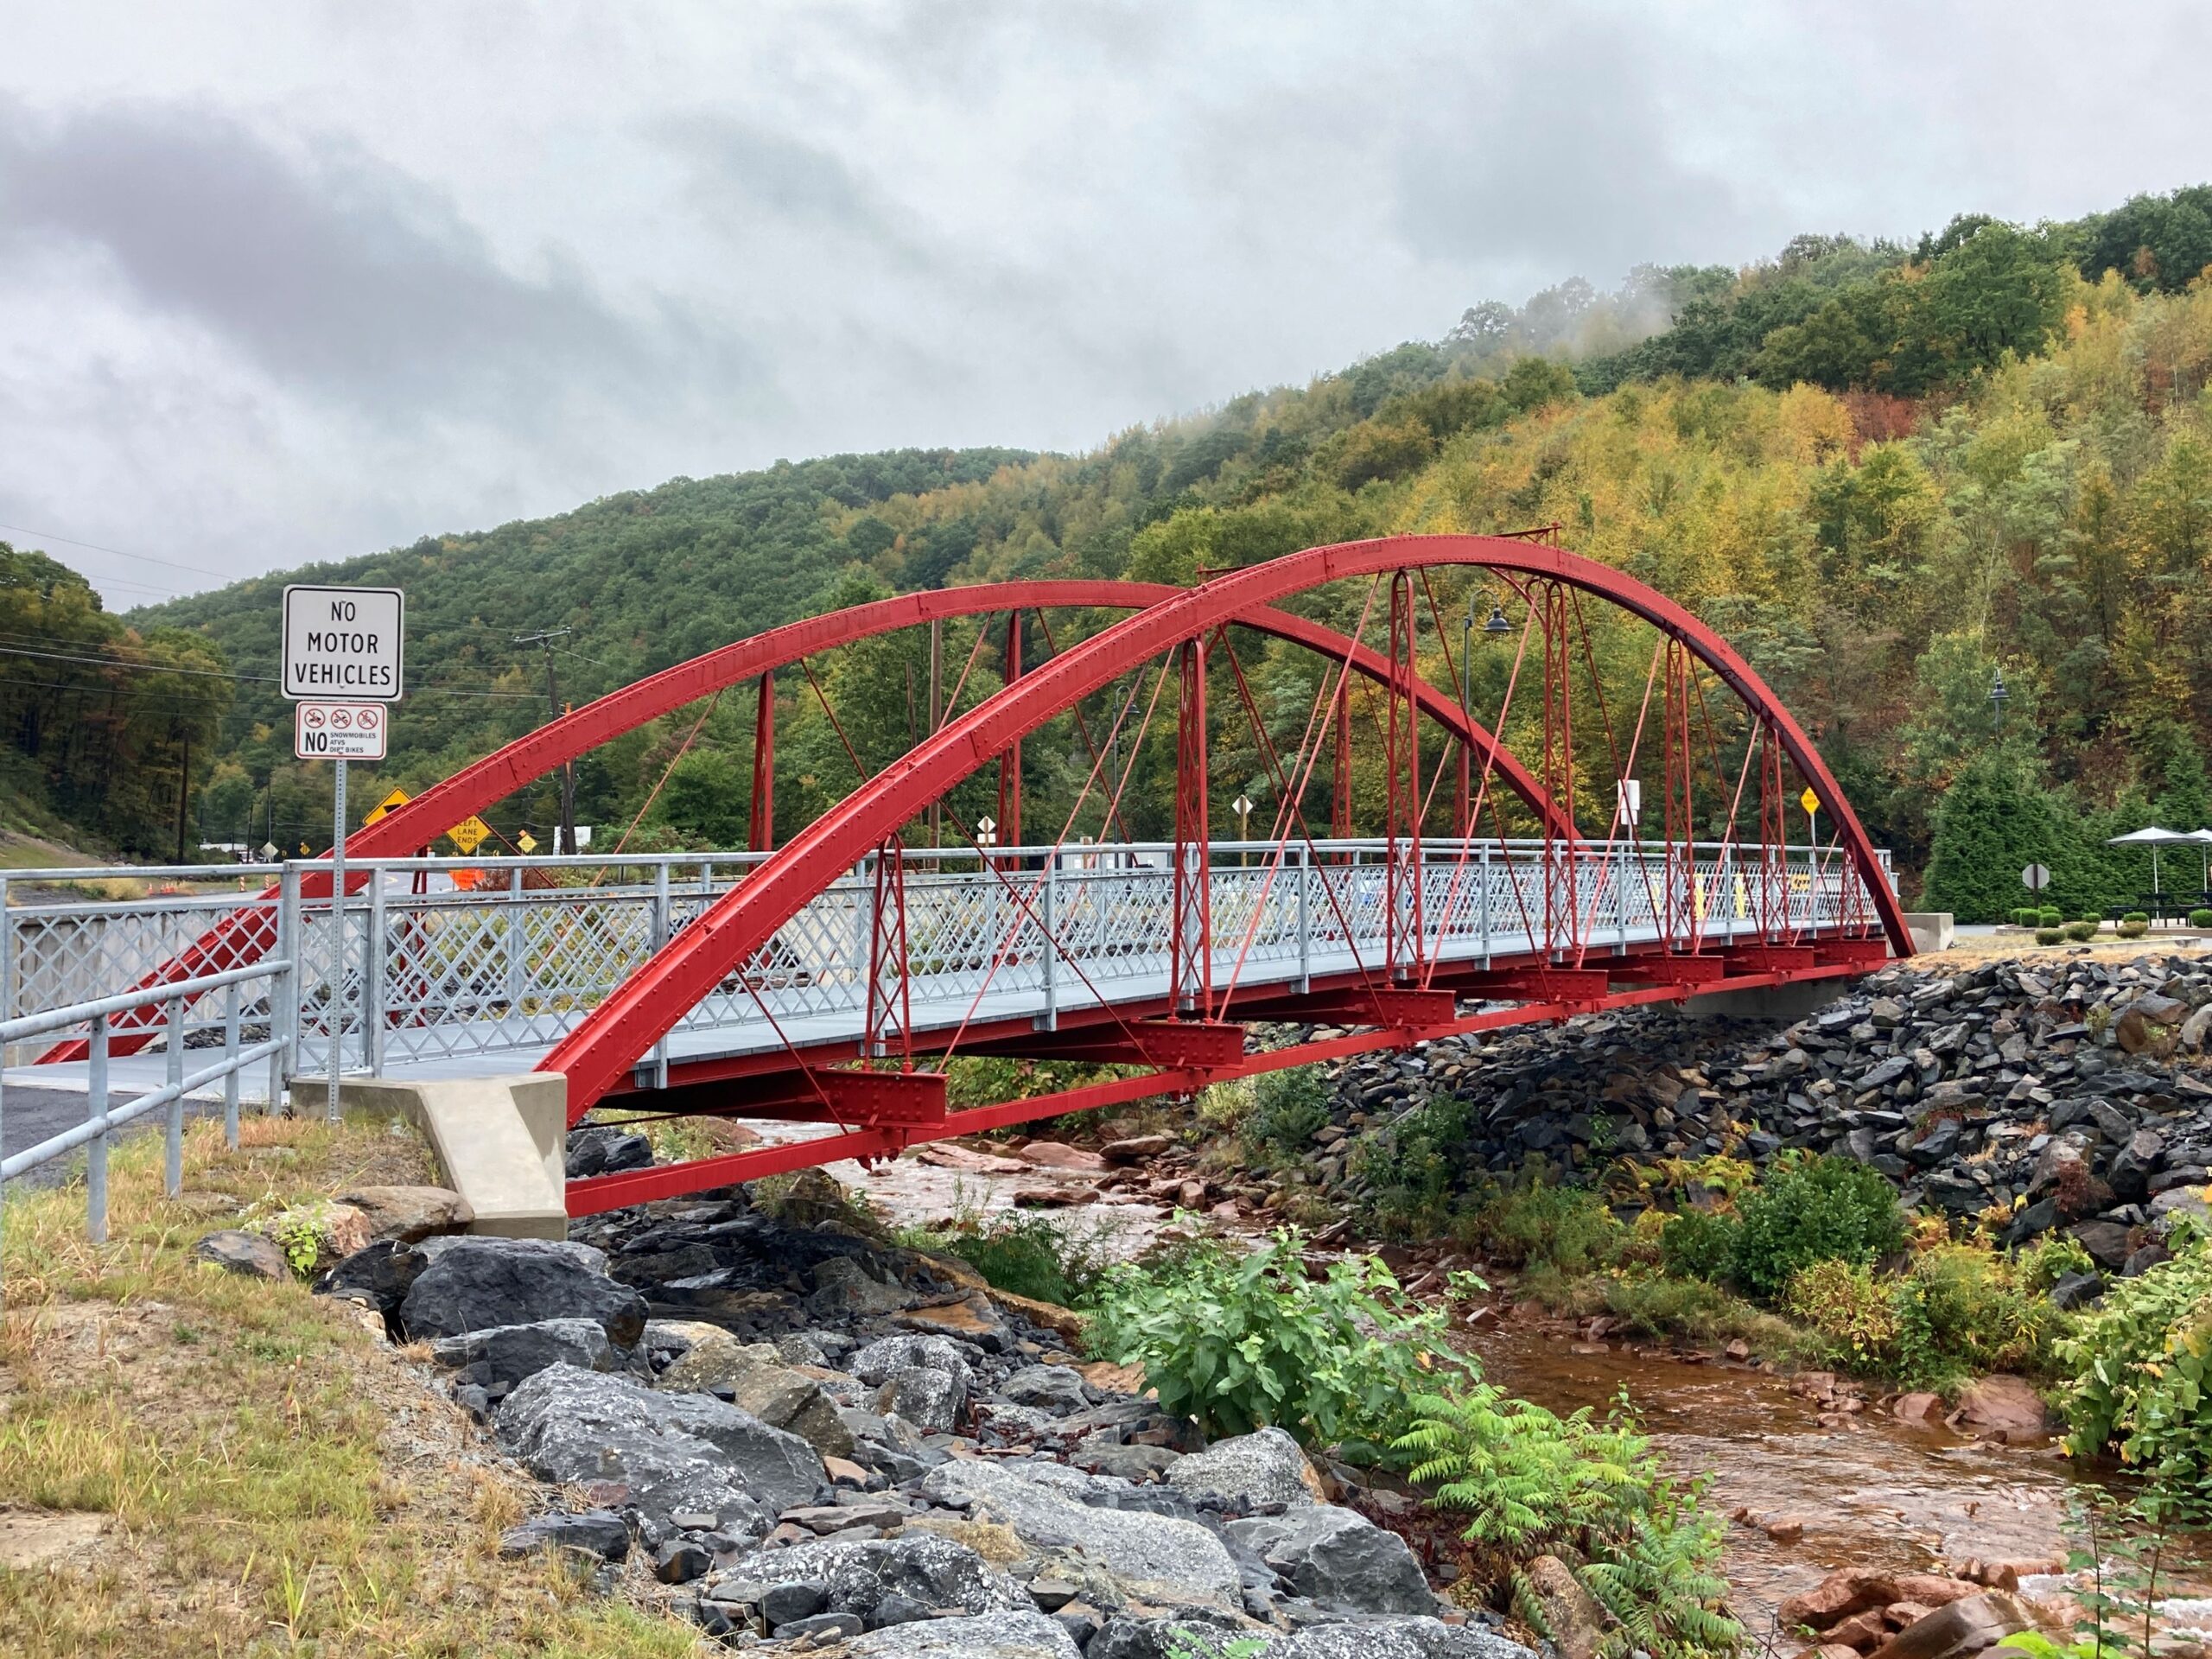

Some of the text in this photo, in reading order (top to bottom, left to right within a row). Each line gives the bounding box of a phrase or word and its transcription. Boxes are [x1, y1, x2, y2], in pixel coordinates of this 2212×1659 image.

[331, 601, 356, 621] NO
[308, 632, 378, 653] MOTOR
[295, 663, 391, 685] VEHICLES
[305, 732, 327, 752] NO
